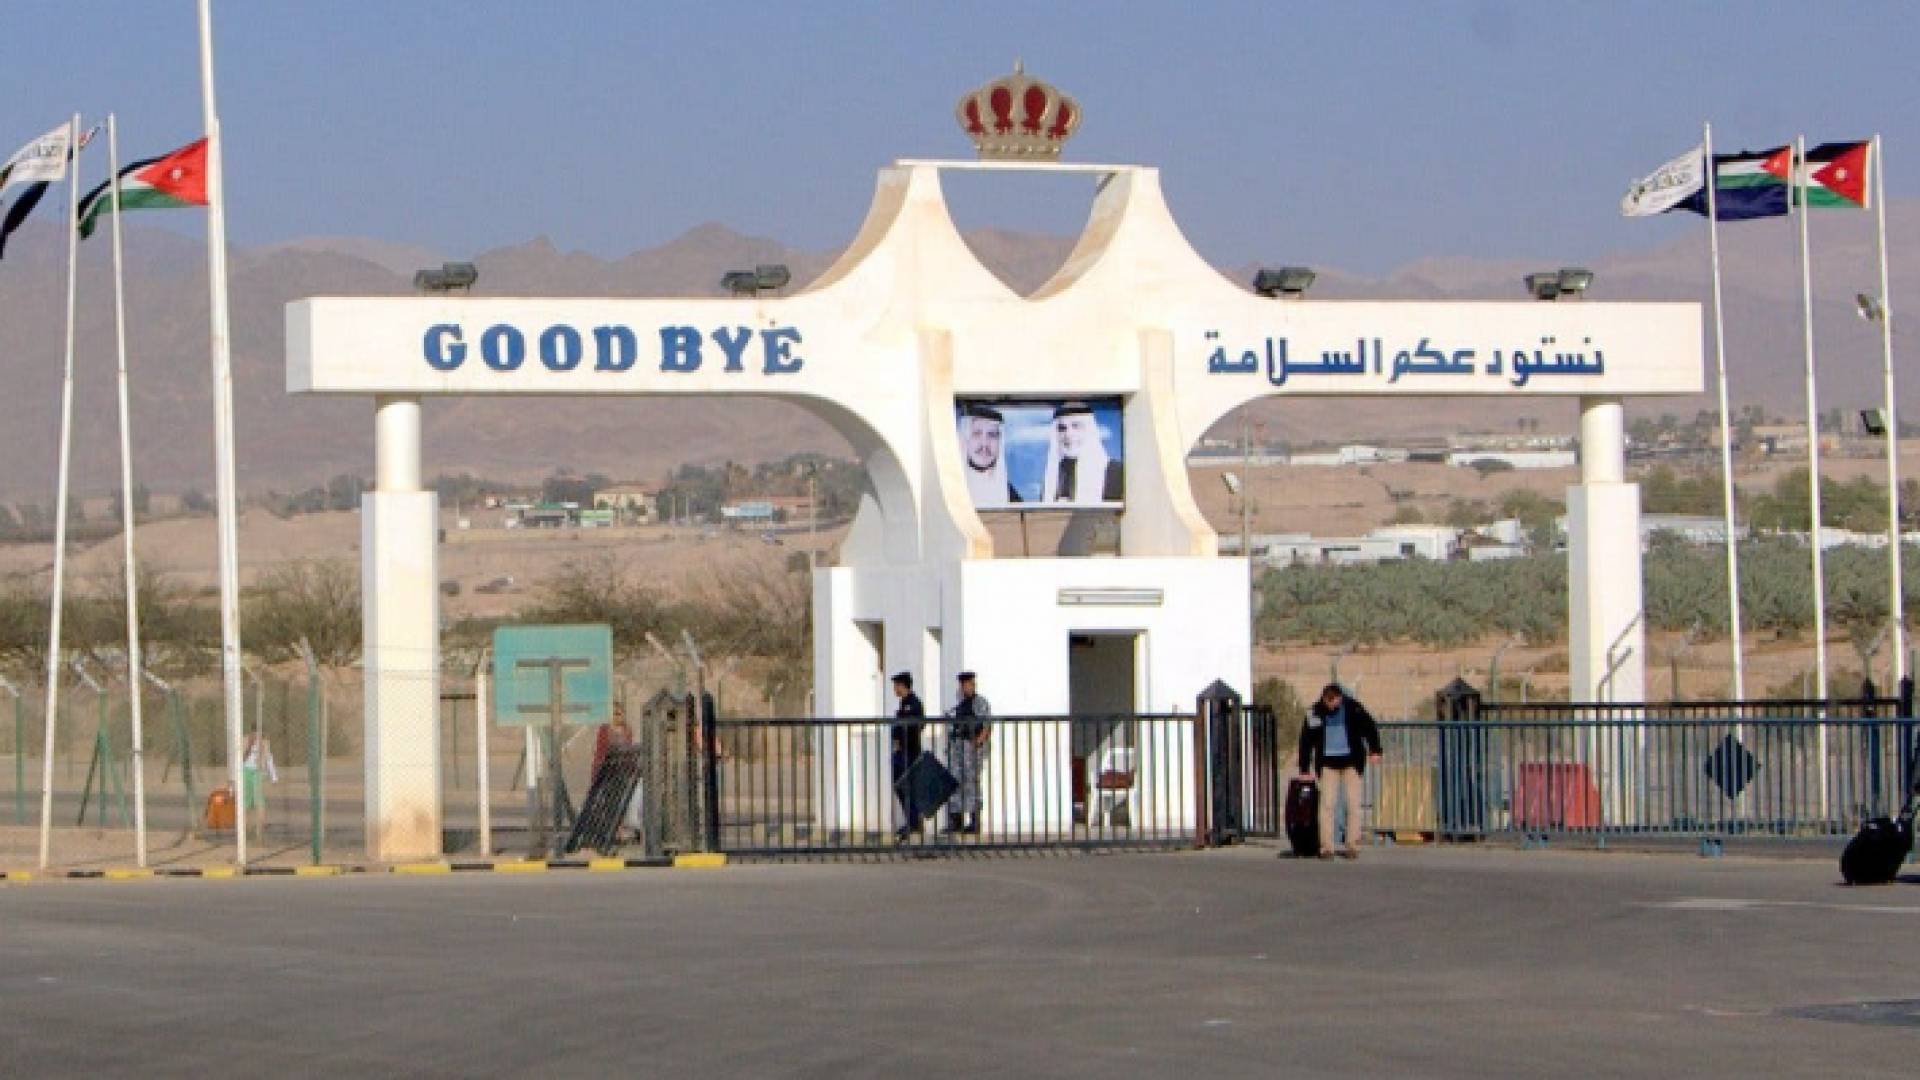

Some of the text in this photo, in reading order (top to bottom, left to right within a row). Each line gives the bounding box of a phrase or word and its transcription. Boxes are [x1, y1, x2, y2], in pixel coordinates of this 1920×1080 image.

[423, 322, 803, 375] GOOD BYE
[1205, 331, 1382, 386] السلامة
